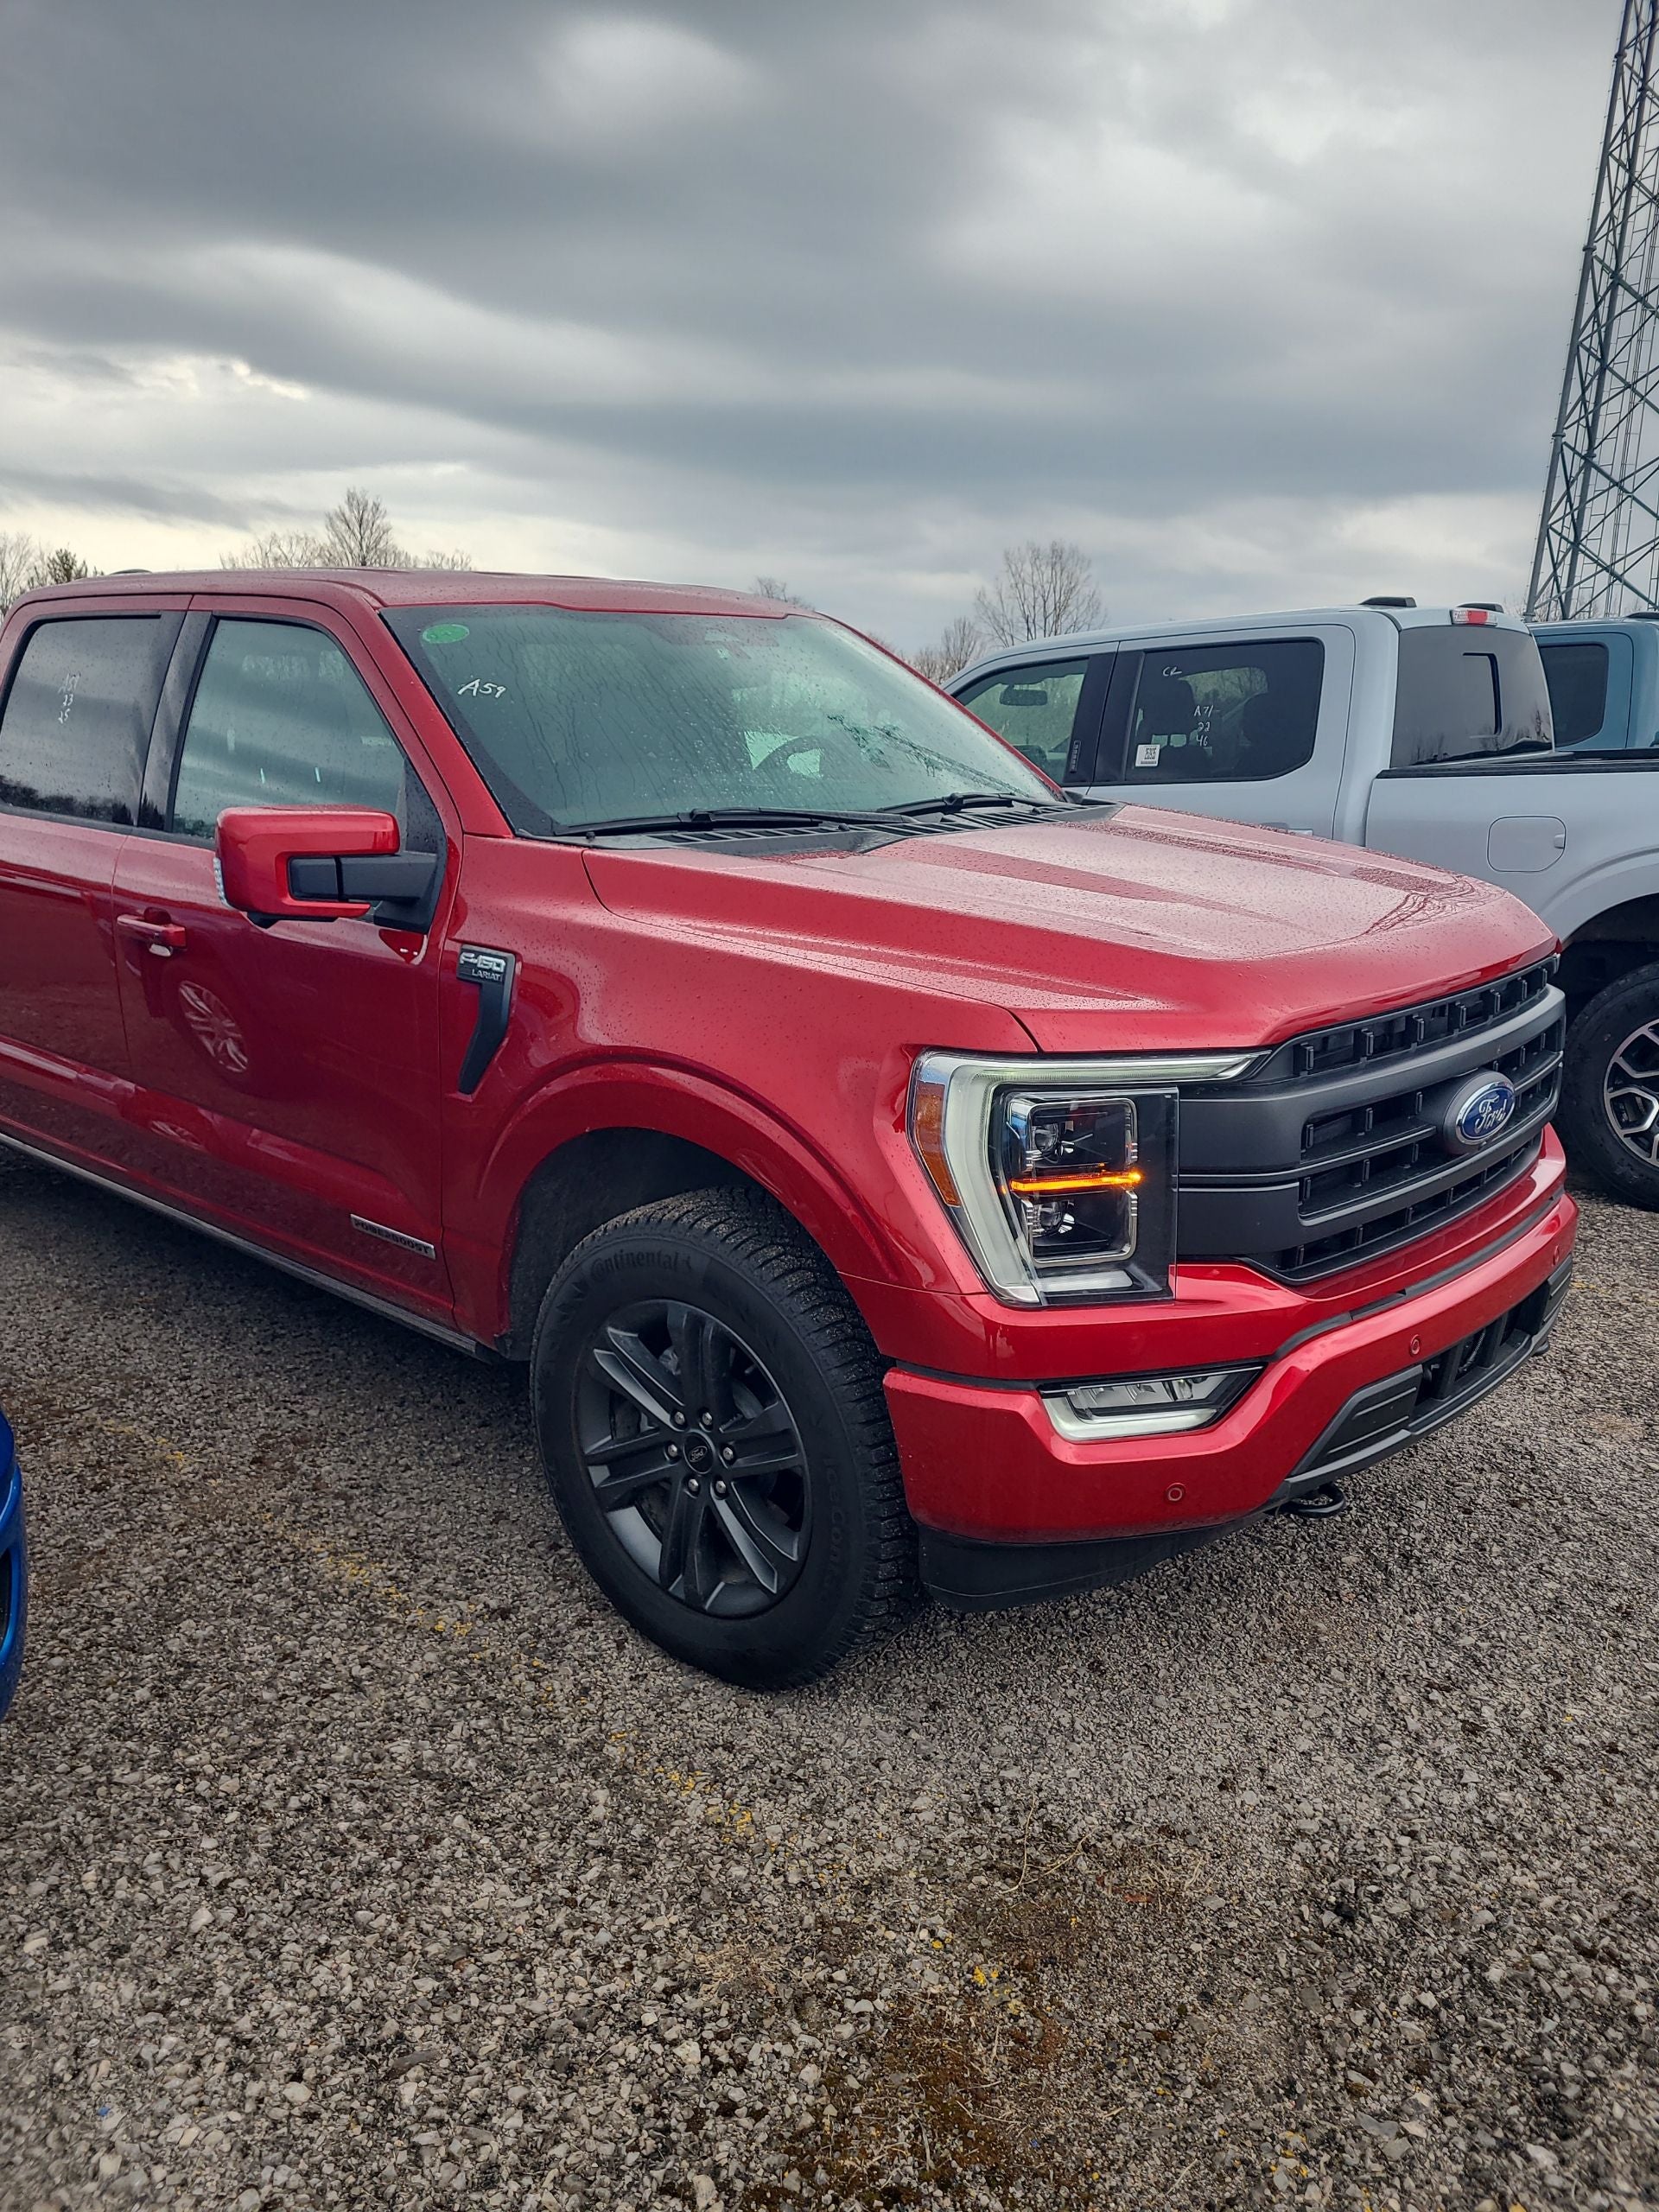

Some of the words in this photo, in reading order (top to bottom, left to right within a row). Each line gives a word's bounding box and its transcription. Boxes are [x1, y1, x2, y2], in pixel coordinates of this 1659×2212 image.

[457, 678, 506, 698] A59
[472, 969, 501, 982] LARIAT
[1474, 1095, 1507, 1134] Ford
[590, 1249, 679, 1281] Continental
